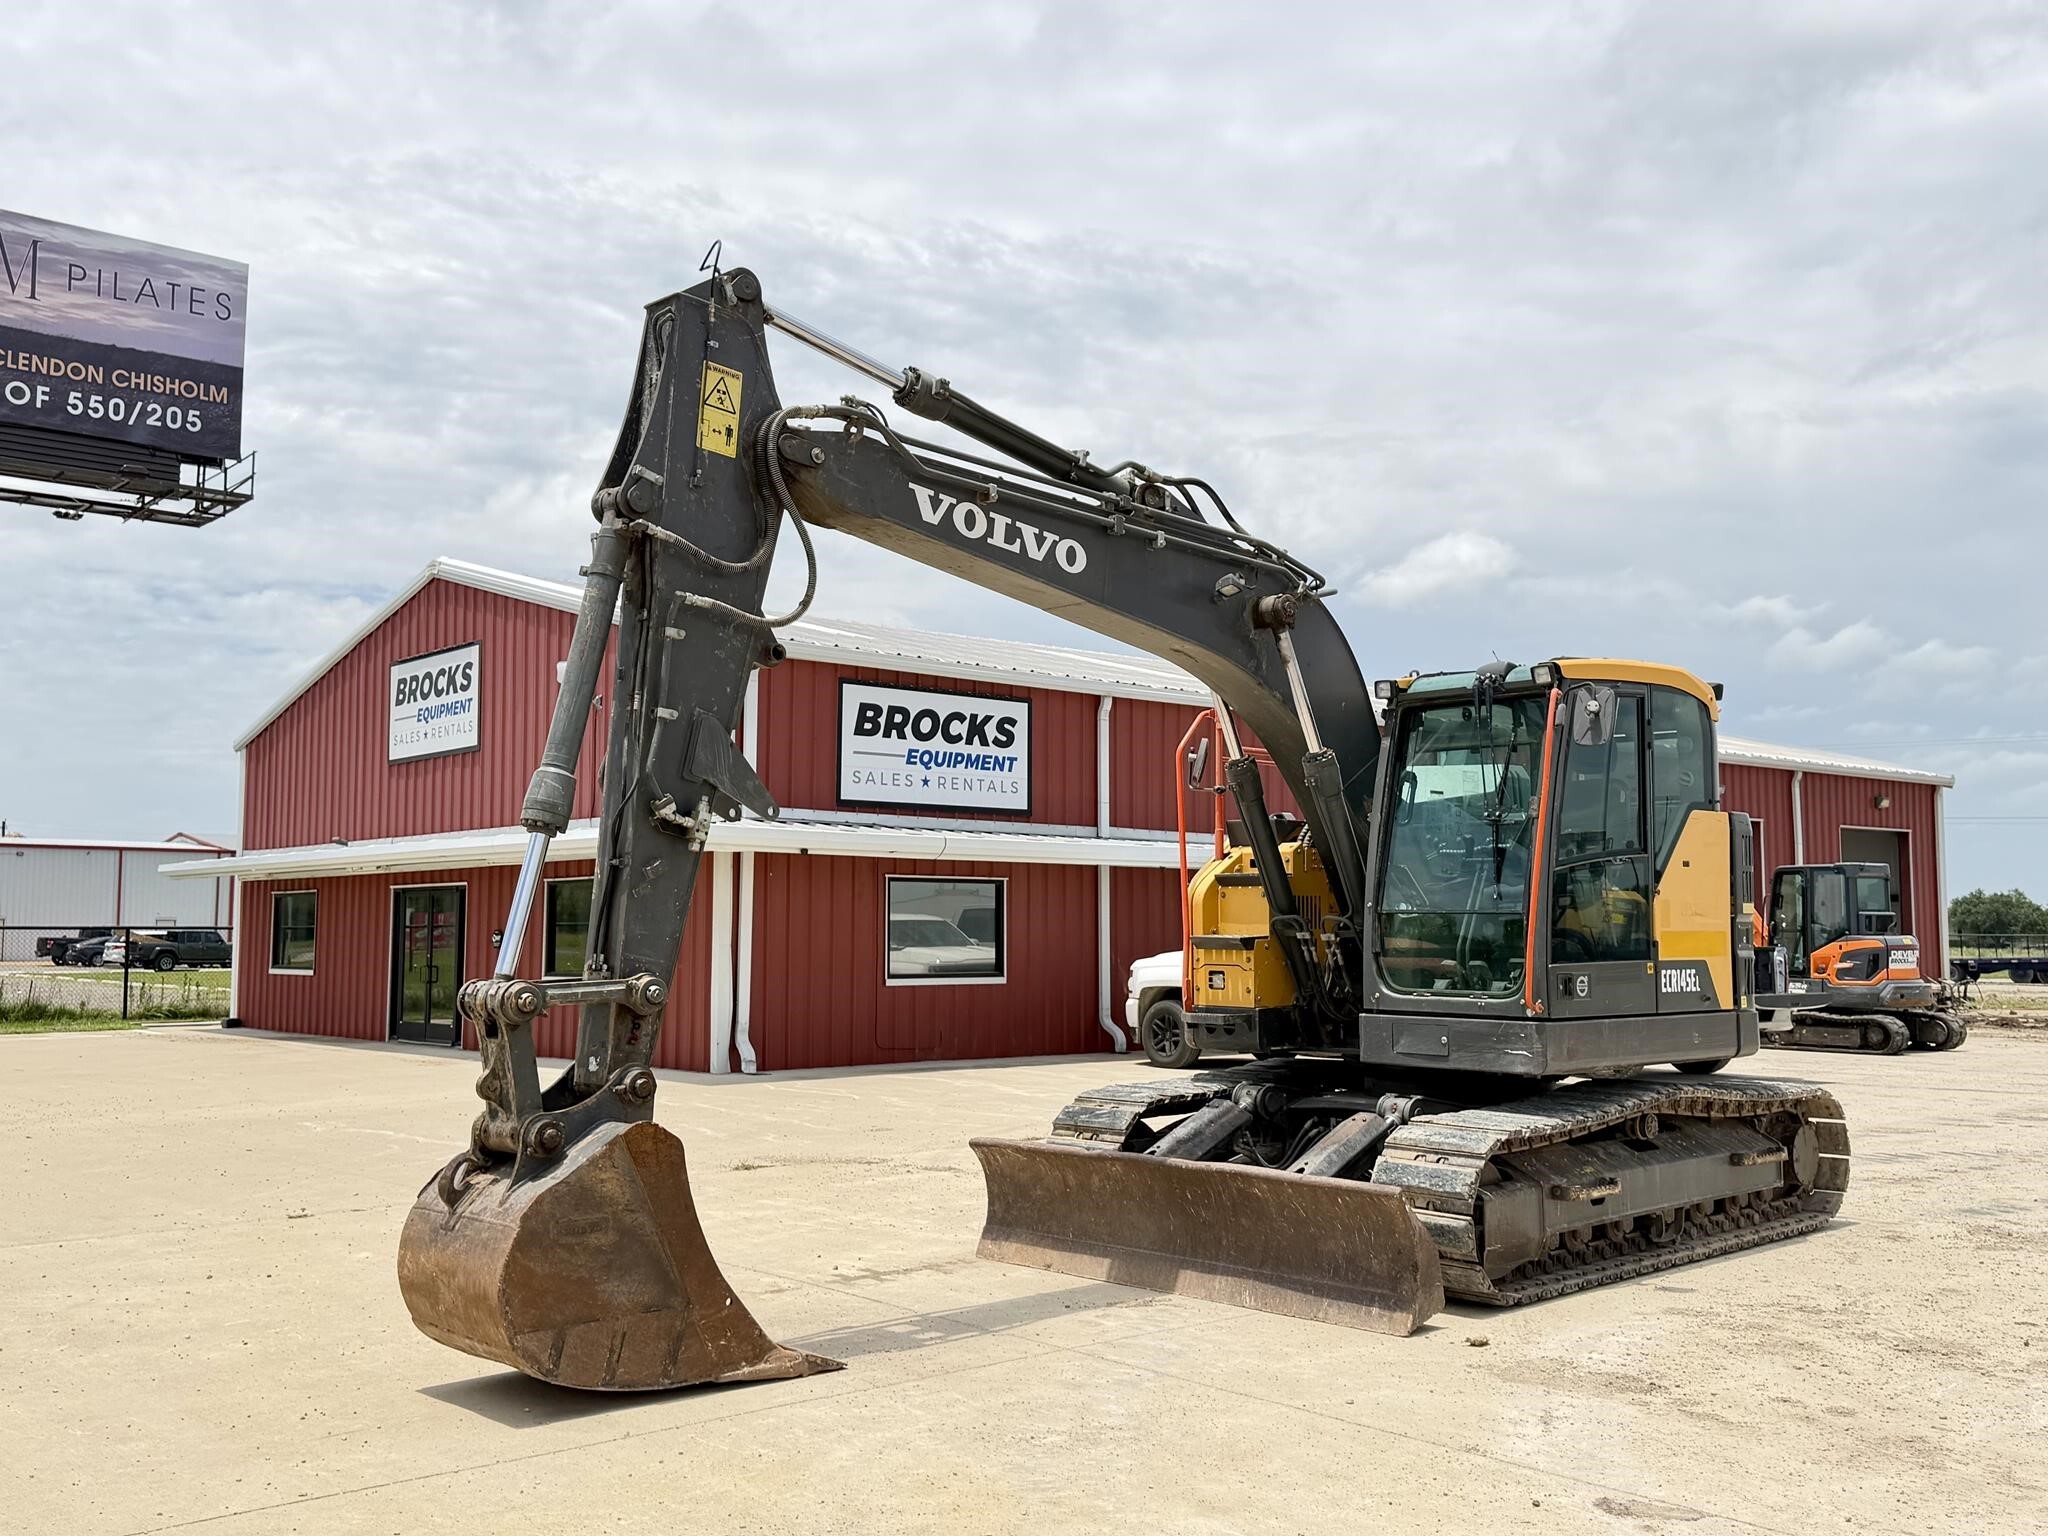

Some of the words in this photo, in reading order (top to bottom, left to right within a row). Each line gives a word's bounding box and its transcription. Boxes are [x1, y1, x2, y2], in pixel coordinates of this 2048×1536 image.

[67, 263, 232, 321] PILATES
[111, 369, 229, 405] CHISHOLM
[712, 366, 740, 379] WARNING
[4, 381, 51, 409] OF
[66, 391, 202, 433] 550/205
[908, 482, 1088, 574] VOLVO
[395, 661, 474, 707] BROCKS
[416, 698, 474, 724] EQUIPMENT
[853, 702, 1018, 748] BROCKS
[393, 730, 421, 746] SALES
[431, 720, 473, 739] RENTALS
[905, 748, 1018, 773] EQUIPMENT
[852, 770, 914, 788] SALES
[937, 776, 1019, 794] RENTALS
